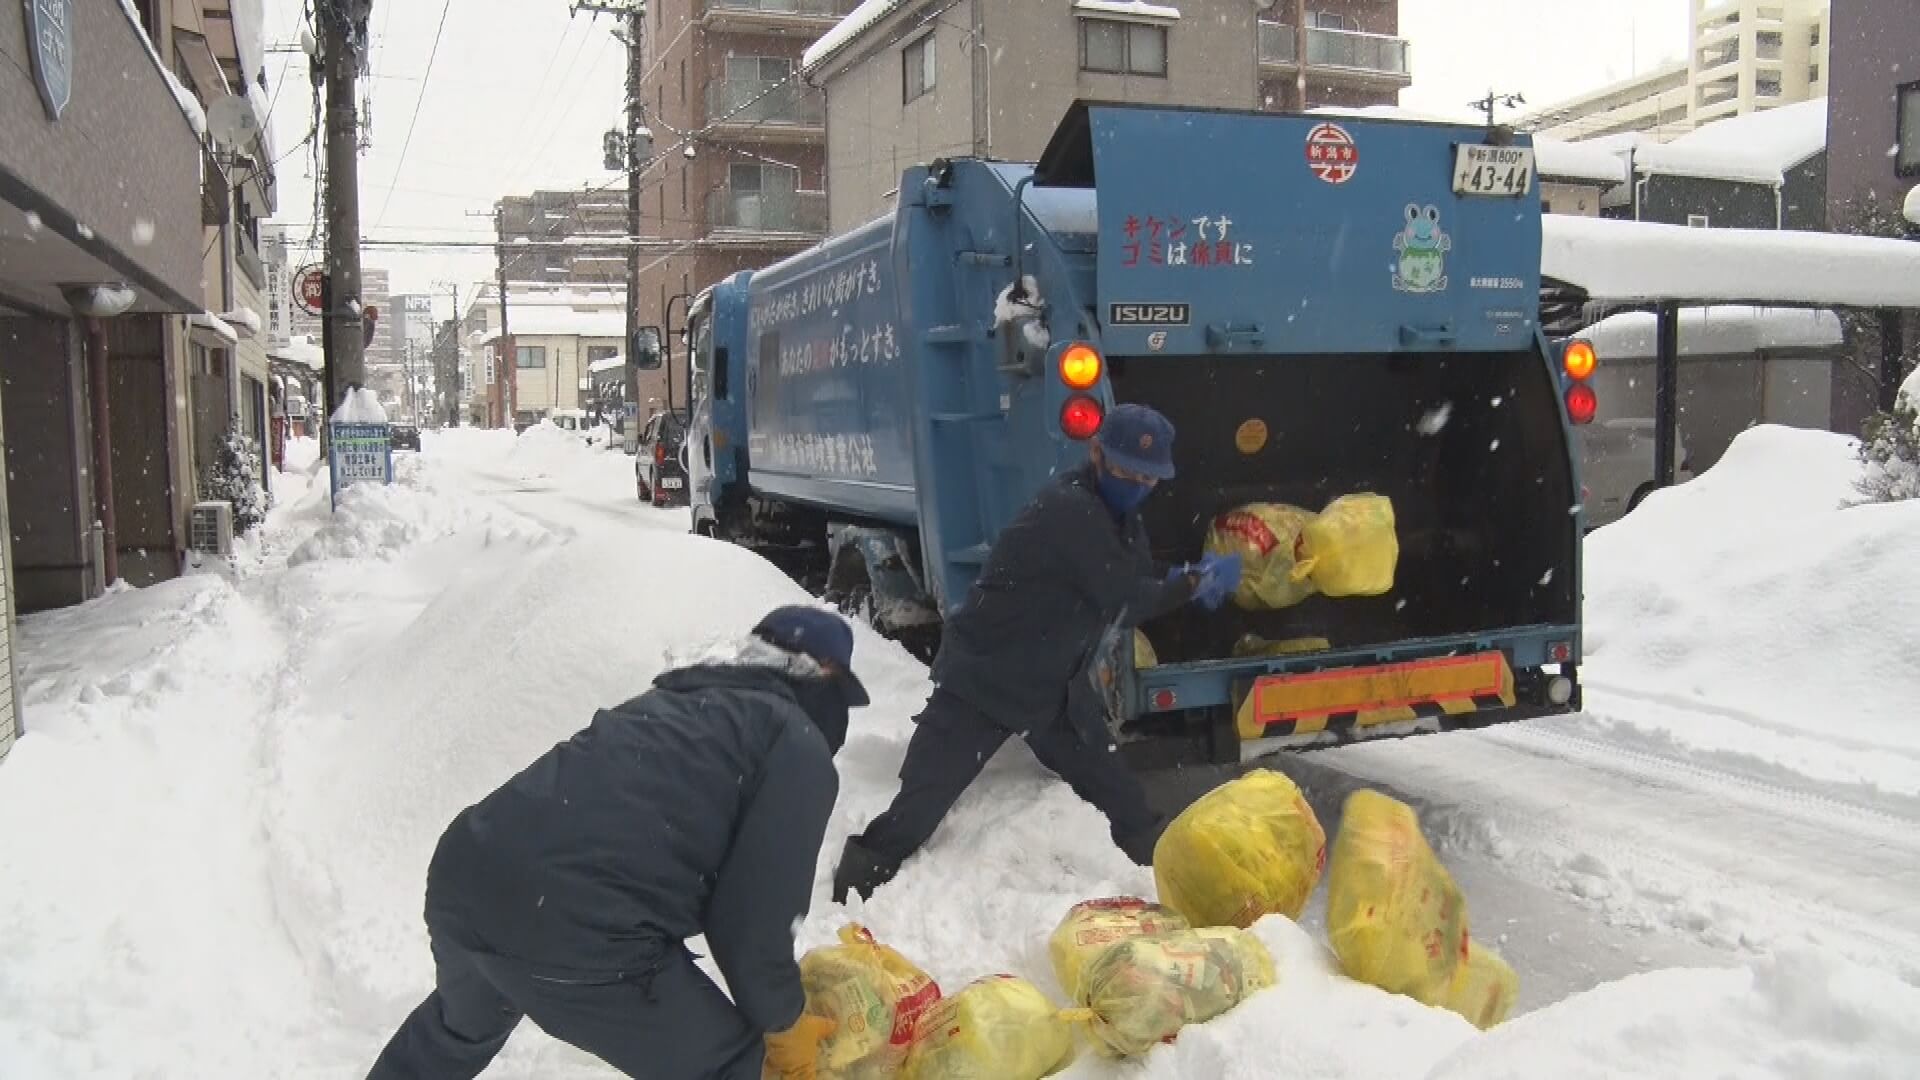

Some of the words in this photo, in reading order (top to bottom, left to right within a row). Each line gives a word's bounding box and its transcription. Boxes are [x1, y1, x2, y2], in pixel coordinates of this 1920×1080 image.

[1310, 144, 1354, 160] 新潟市
[1471, 165, 1528, 193] 43-44
[1122, 214, 1234, 241] キケンです
[1121, 241, 1254, 267] ゴミは係員に
[1115, 305, 1185, 322] ISUZU
